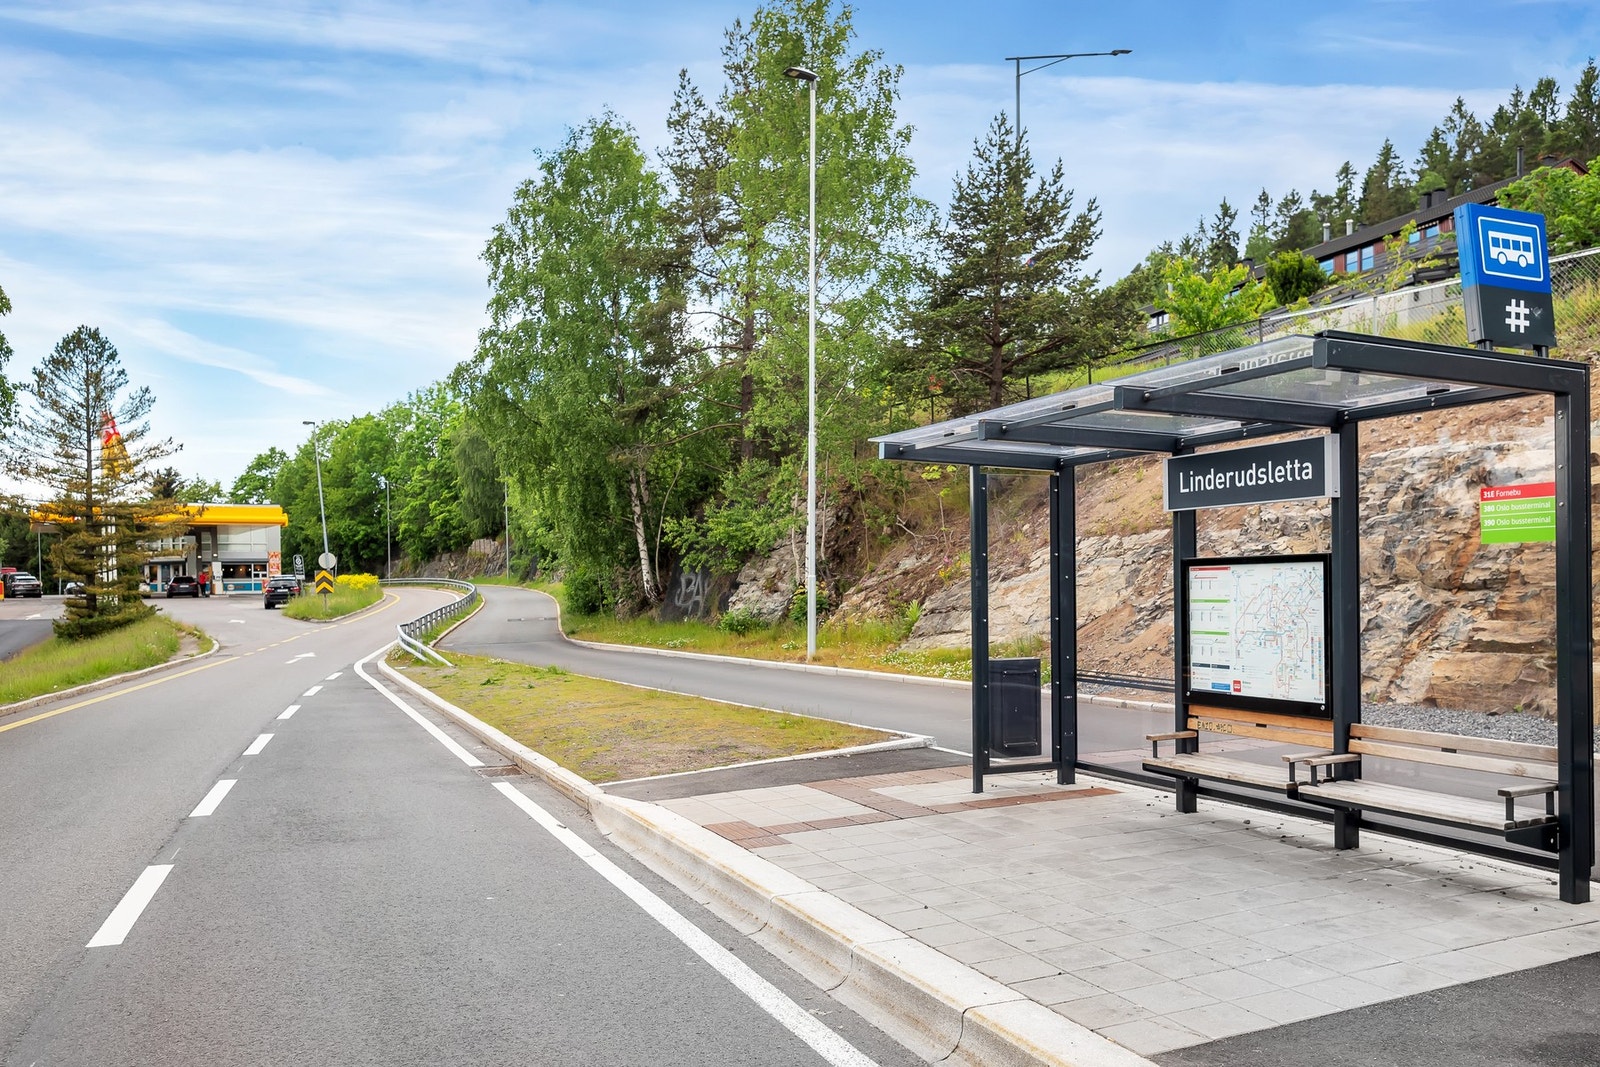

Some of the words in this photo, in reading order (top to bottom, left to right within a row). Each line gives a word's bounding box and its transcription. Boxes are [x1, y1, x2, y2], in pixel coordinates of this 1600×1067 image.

[1179, 459, 1313, 494] Linderudsletta
[1496, 489, 1521, 497] Fornebu
[1511, 501, 1551, 510] bussterminal
[1496, 518, 1510, 526] Oslo
[1511, 516, 1551, 525] bussterminal
